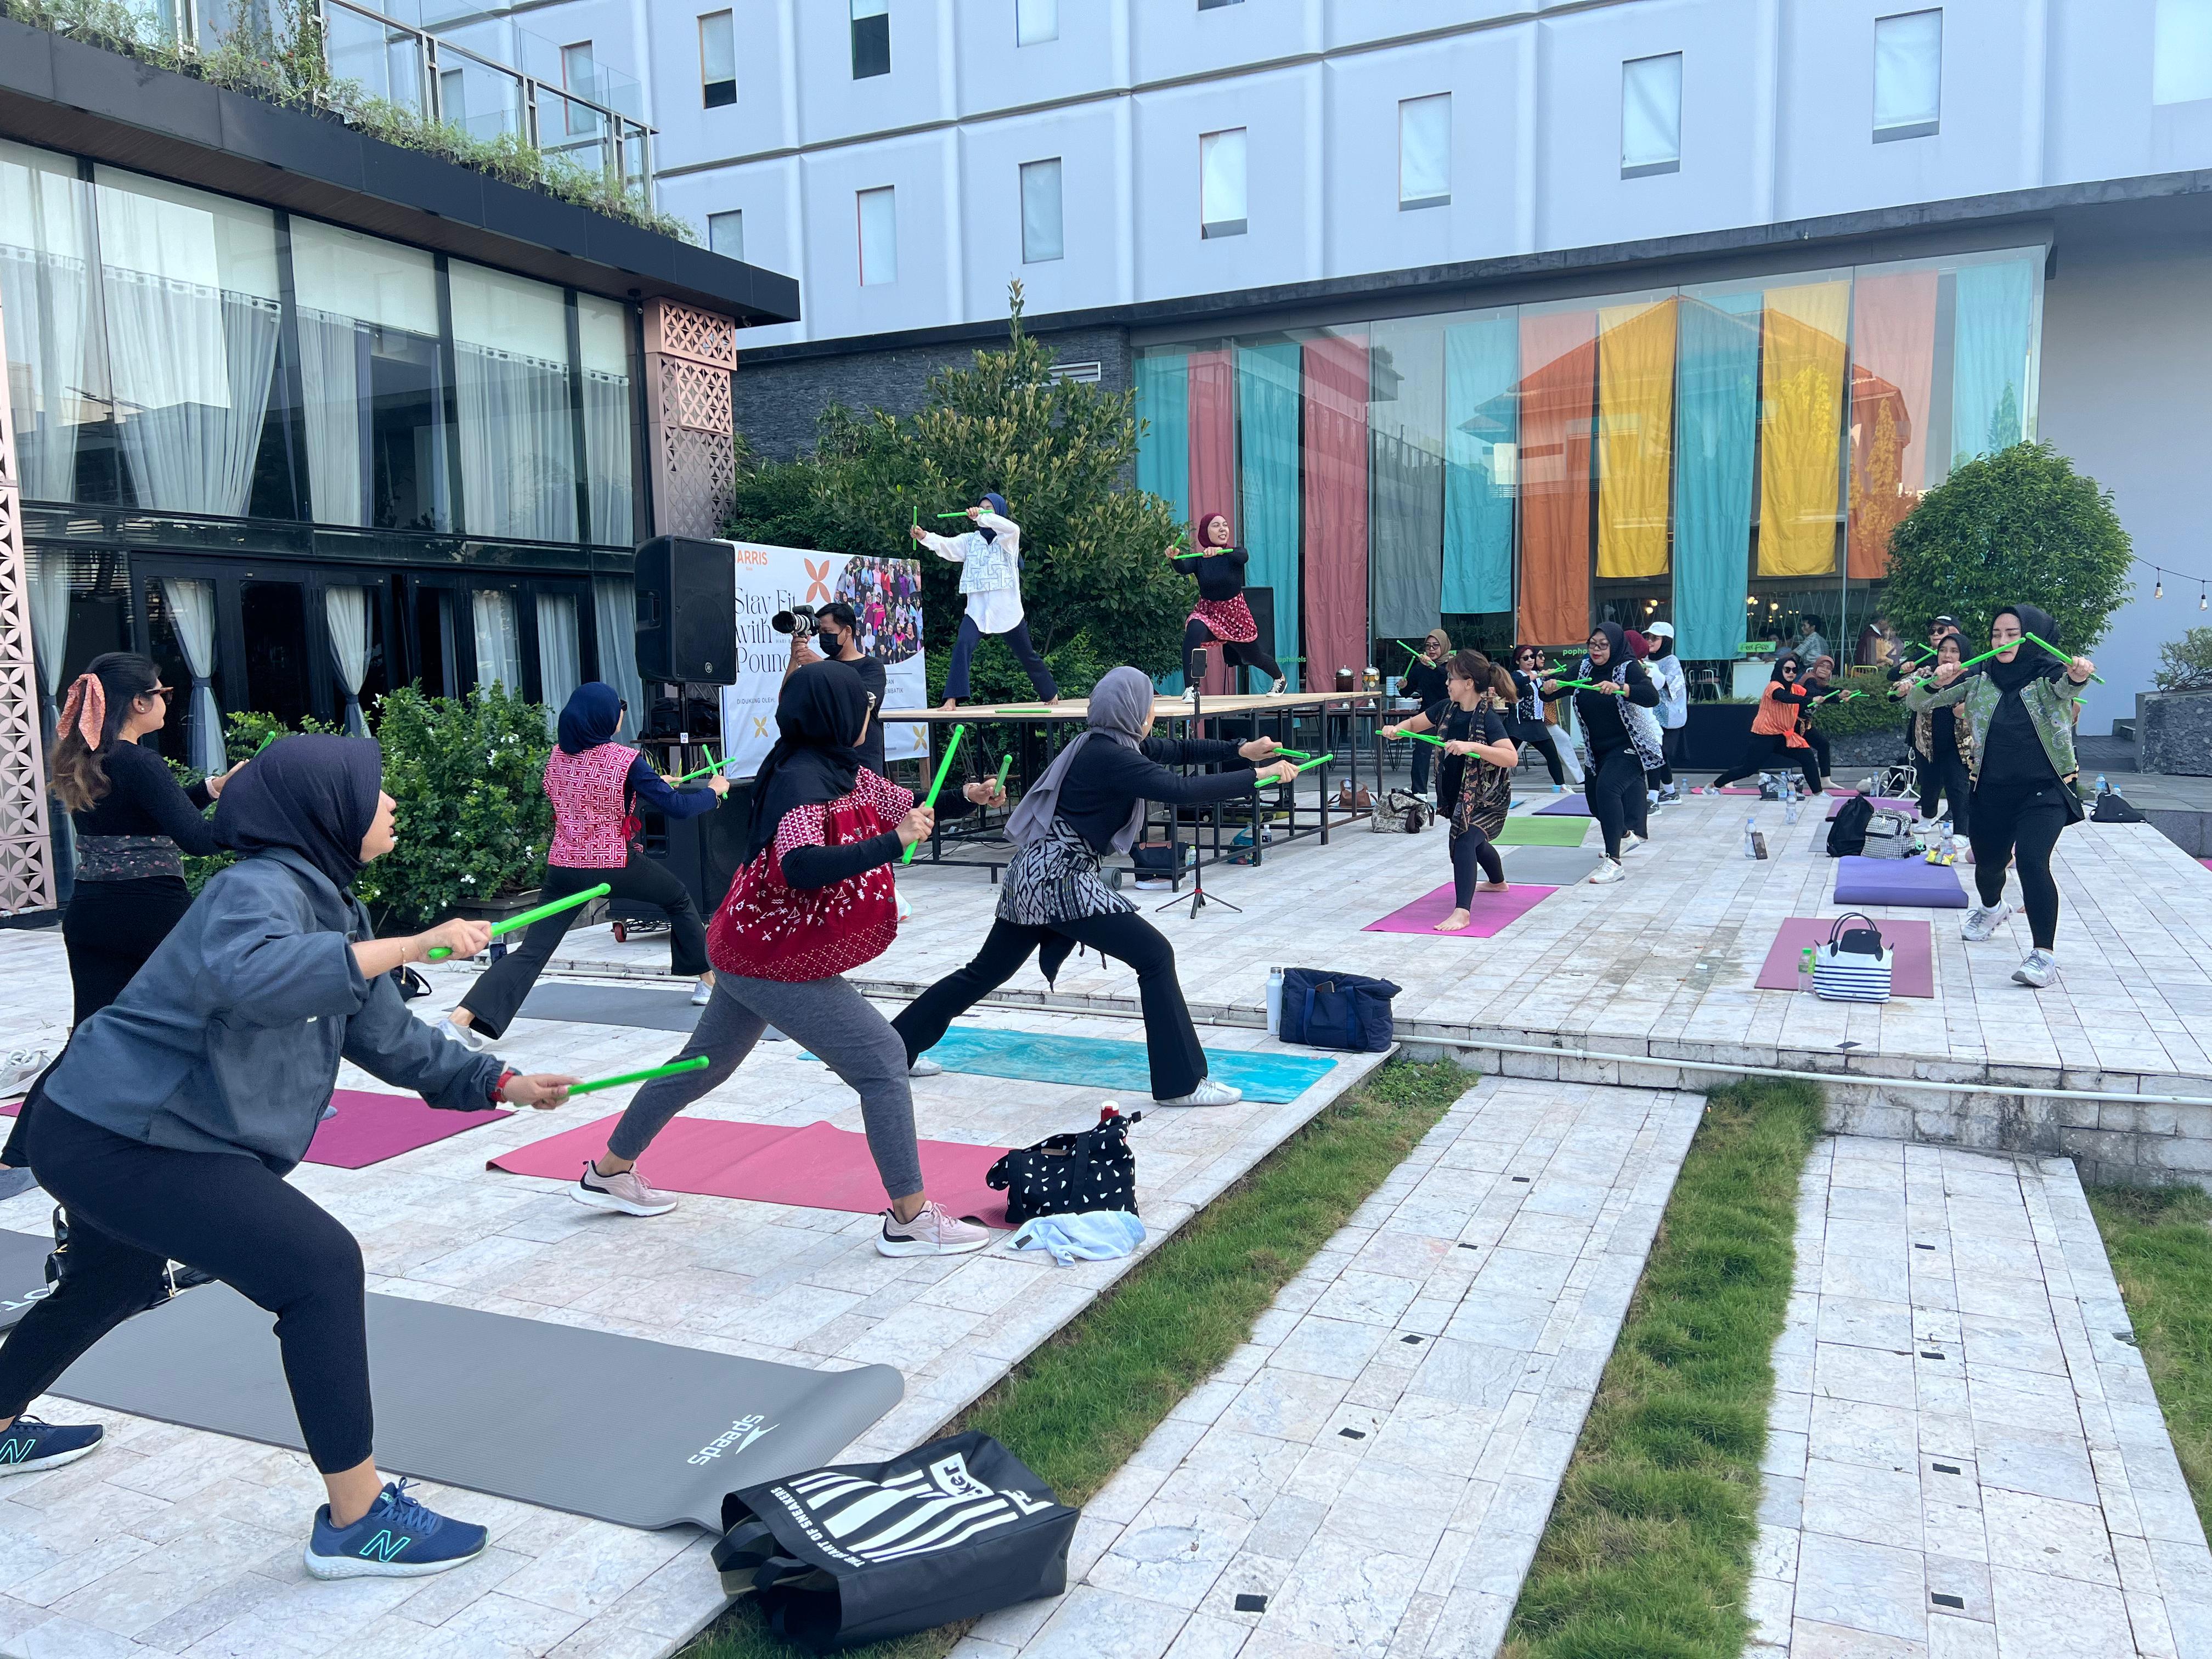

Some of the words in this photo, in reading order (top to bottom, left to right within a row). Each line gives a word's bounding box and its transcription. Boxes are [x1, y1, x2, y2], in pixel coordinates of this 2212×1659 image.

[737, 550, 768, 566] ARRIS
[735, 587, 771, 624] Stay
[776, 589, 795, 613] Fit
[735, 618, 772, 644] with
[1562, 647, 1588, 657] popho
[770, 1486, 813, 1529] SNEAKERS
[806, 1528, 823, 1541] OF
